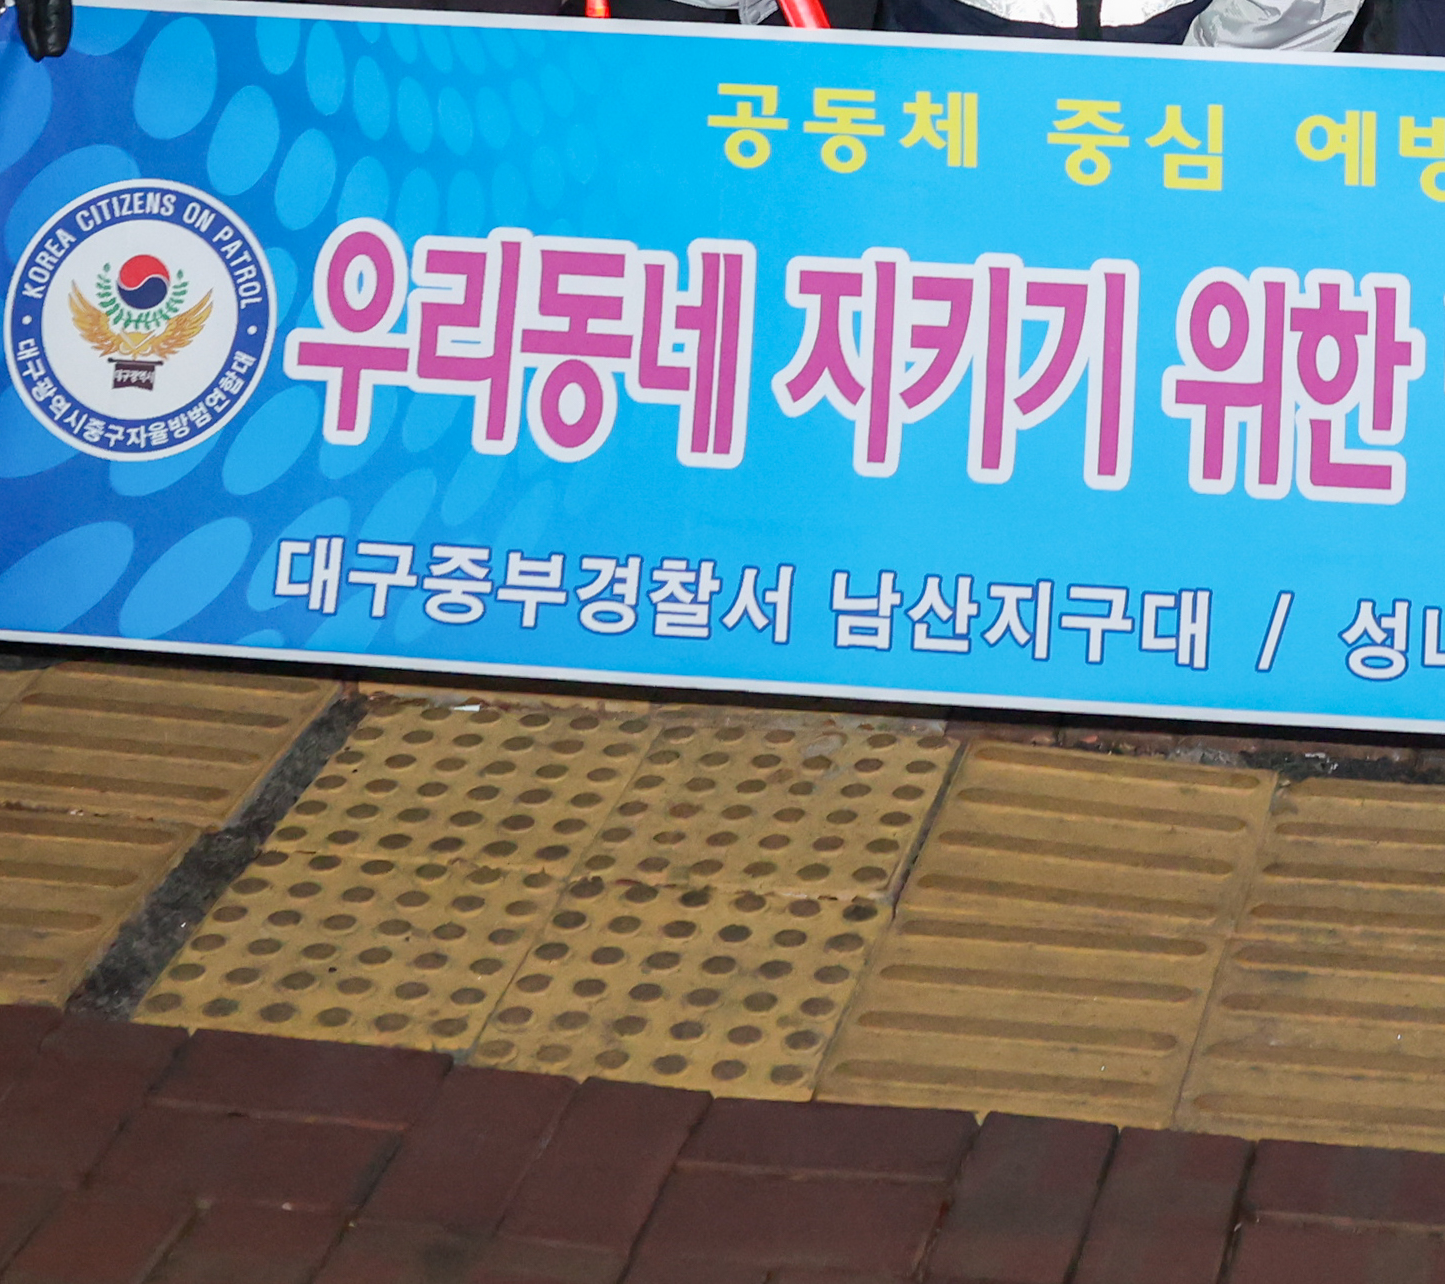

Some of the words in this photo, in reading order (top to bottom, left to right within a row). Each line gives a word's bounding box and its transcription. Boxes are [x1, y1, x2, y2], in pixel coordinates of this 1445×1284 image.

[707, 82, 979, 173] 공동체
[1047, 97, 1225, 192] 중심
[22, 228, 77, 299] KOREA
[75, 191, 177, 232] CITIZENS
[182, 202, 217, 233] ON
[211, 226, 263, 310] PATROL
[289, 222, 752, 464] 우리동네
[778, 252, 1135, 485] 지키기
[1166, 272, 1421, 499] 위한
[274, 535, 793, 645] 대구중부경찰서
[829, 569, 1212, 672] 남산지구대
